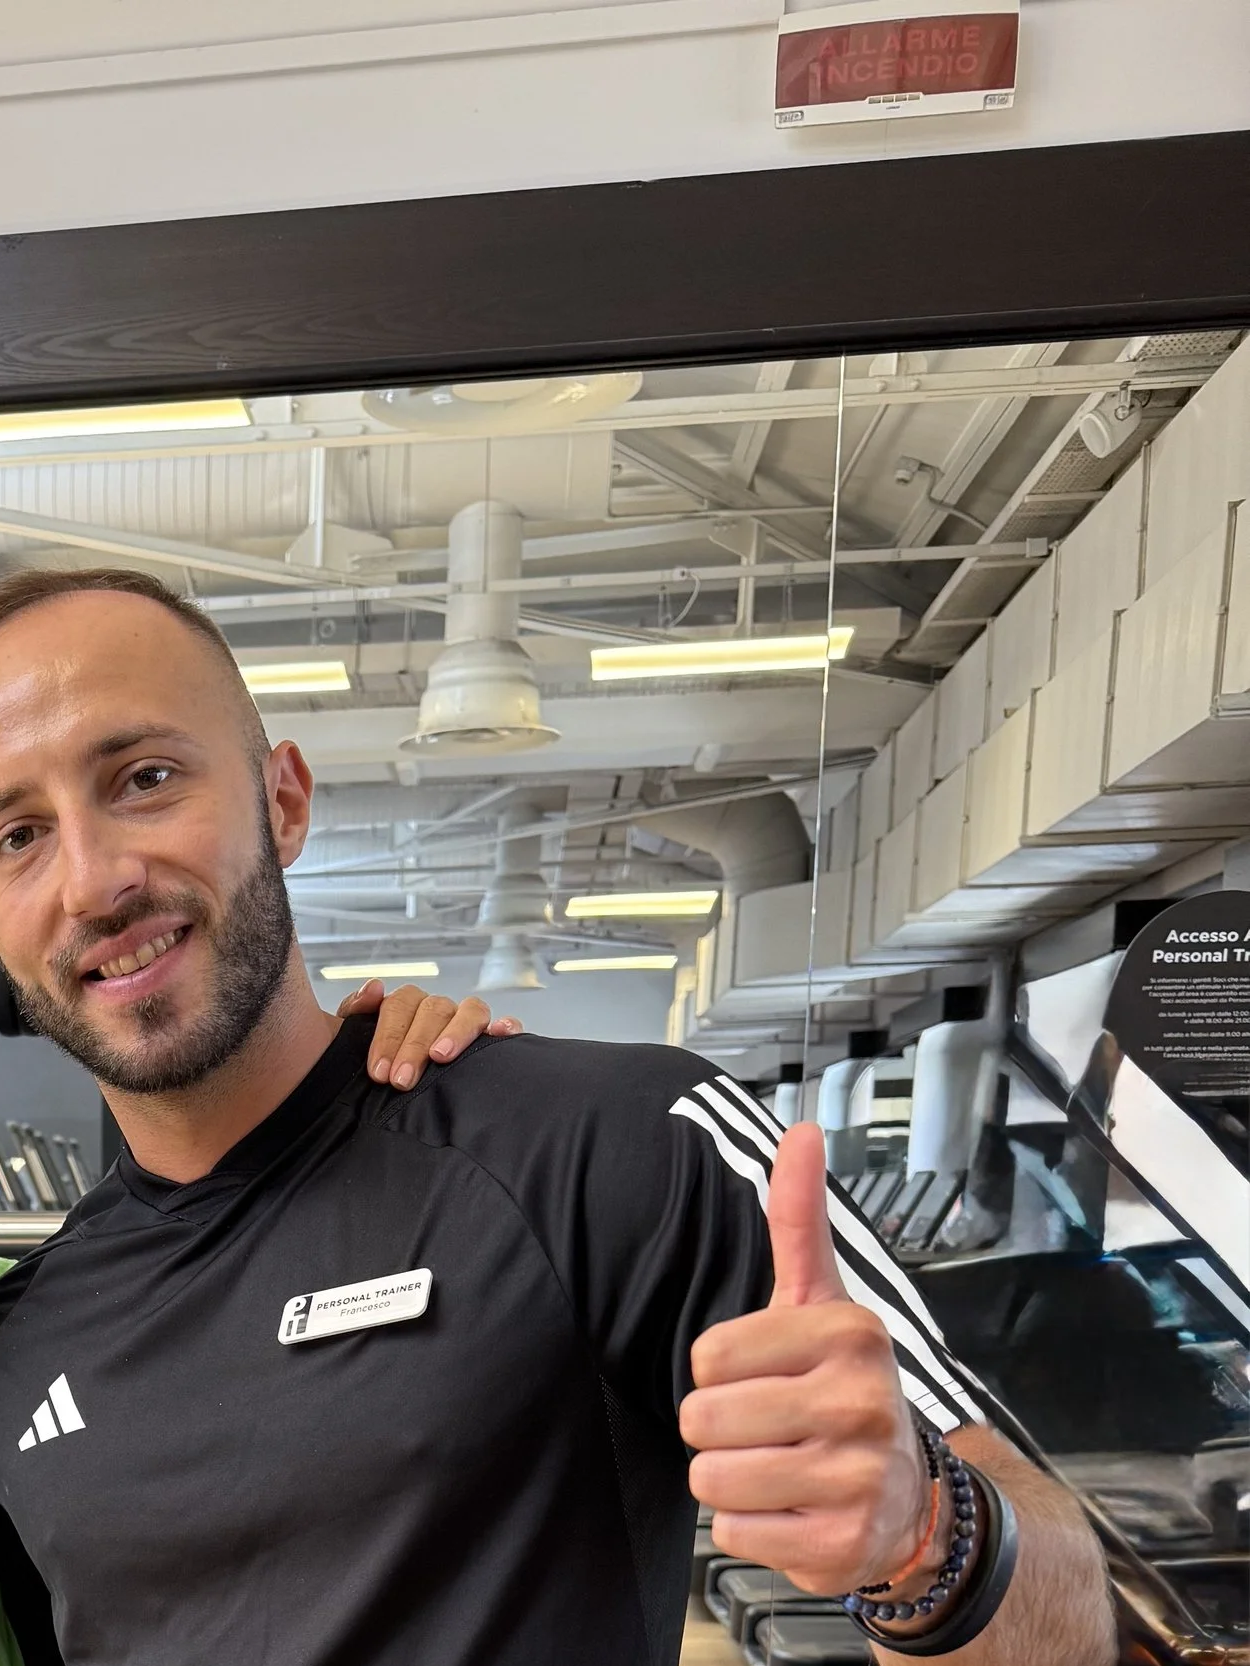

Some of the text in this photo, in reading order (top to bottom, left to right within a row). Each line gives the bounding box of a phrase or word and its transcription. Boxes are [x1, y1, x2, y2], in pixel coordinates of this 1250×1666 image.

[819, 24, 981, 58] ALLARME
[816, 53, 978, 85] INCENDIO
[1165, 929, 1239, 943] Accesso
[1152, 948, 1228, 963] Personal
[316, 1281, 422, 1311] PERSONAL TRAINER
[339, 1300, 391, 1317] Francesco
